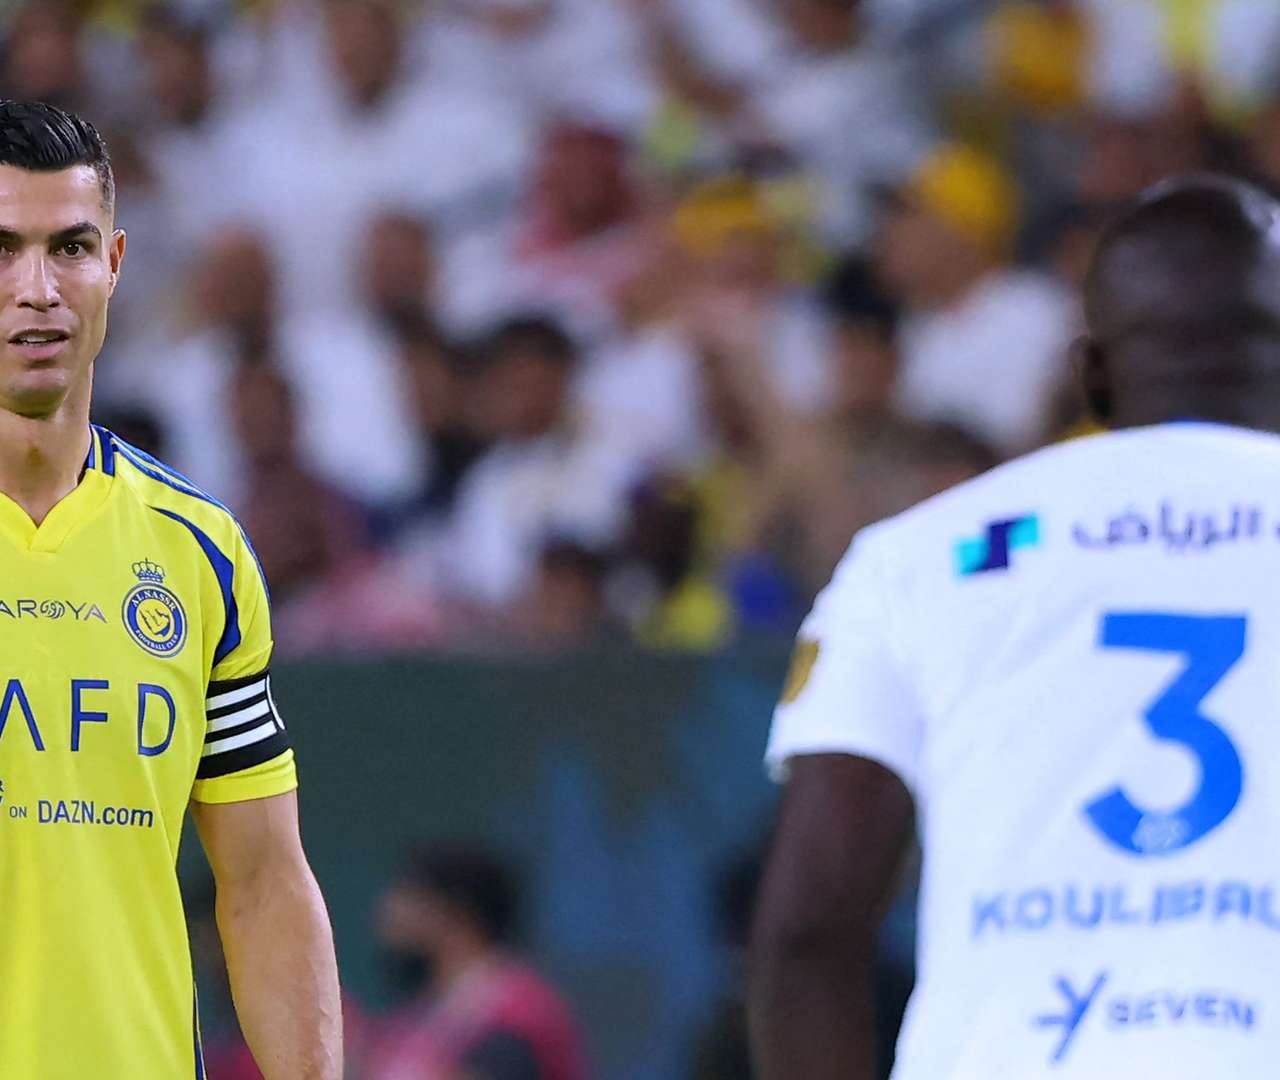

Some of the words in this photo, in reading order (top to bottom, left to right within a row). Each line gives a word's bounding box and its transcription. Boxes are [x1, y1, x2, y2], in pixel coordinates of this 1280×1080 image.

[1070, 497, 1263, 556] الرياض
[1082, 609, 1250, 858] 3
[9, 805, 28, 818] ON
[38, 800, 154, 828] DAZN.com
